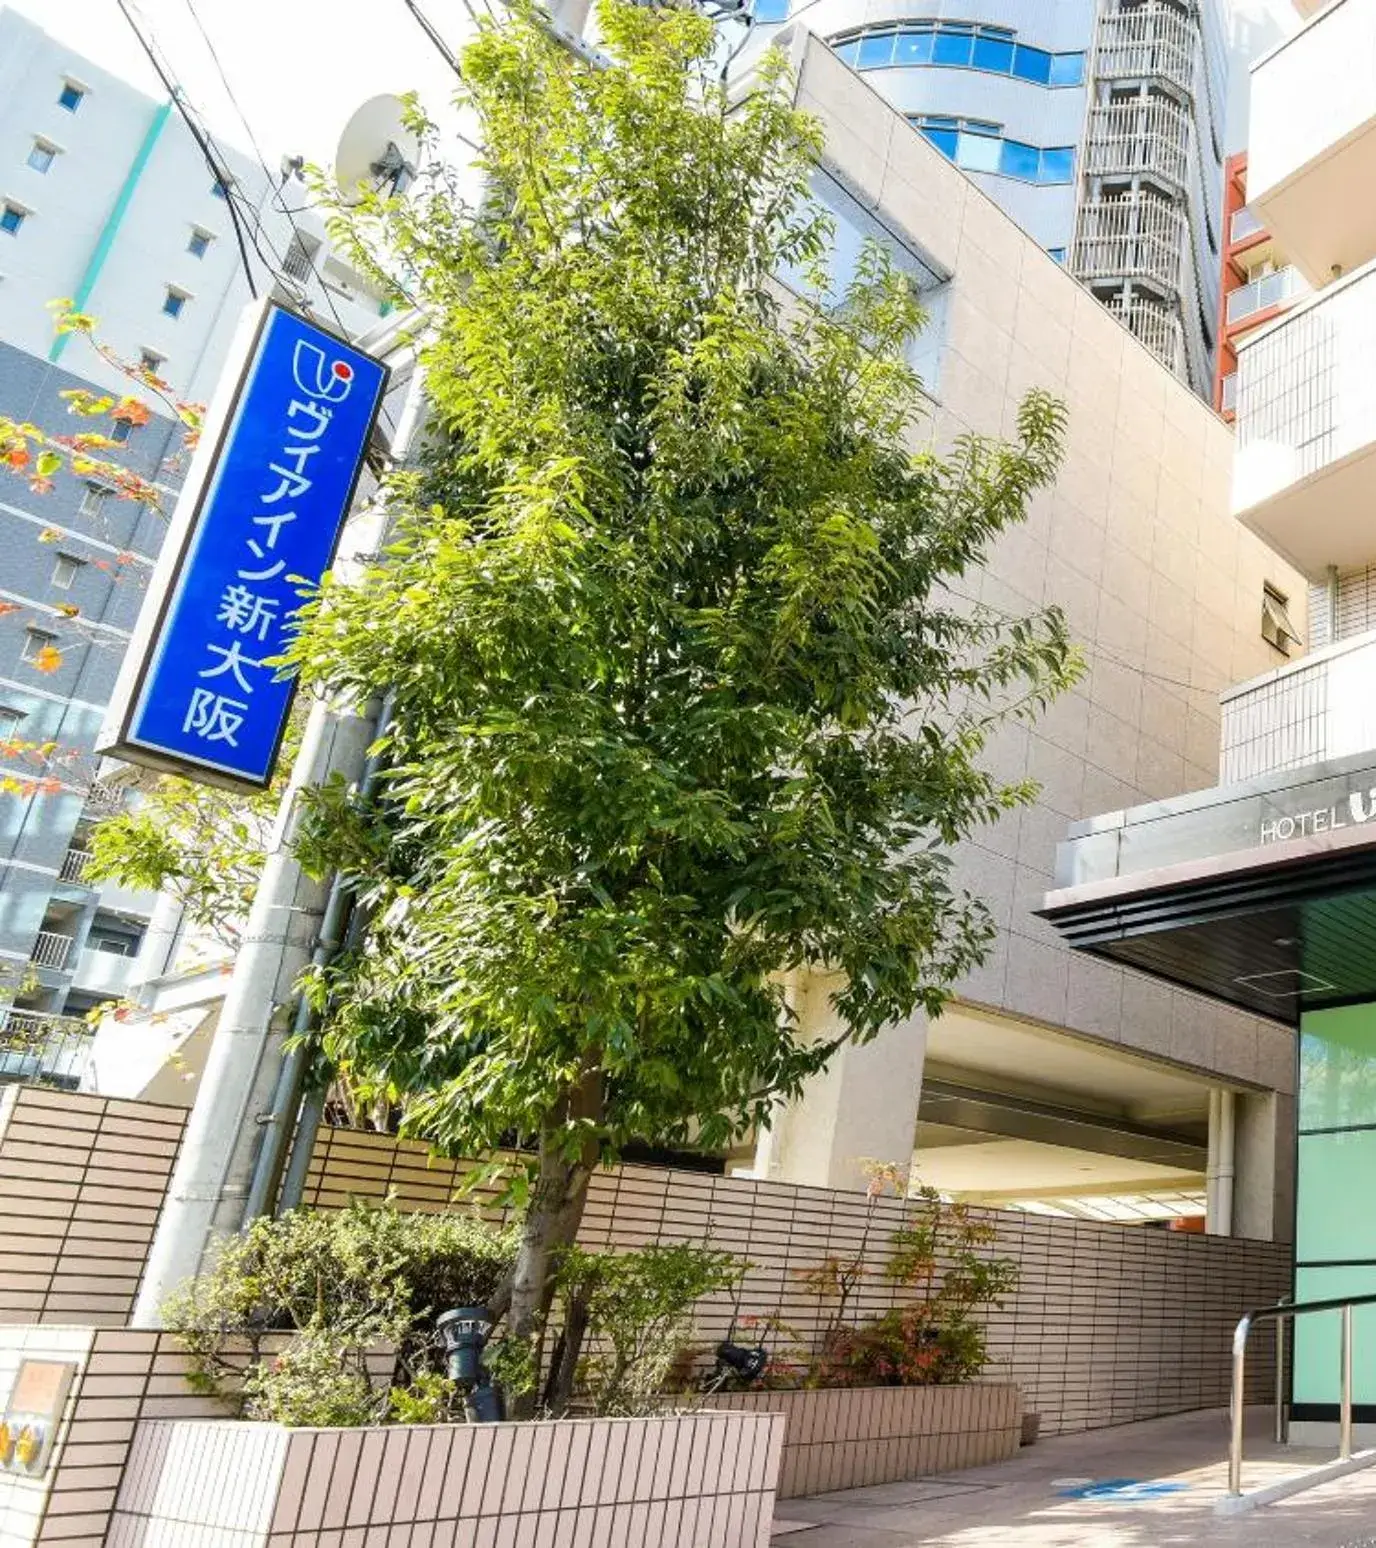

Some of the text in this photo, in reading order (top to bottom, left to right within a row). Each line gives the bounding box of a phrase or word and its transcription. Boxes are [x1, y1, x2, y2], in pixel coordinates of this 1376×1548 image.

[182, 398, 334, 748] ヴィアイン新大阪
[1260, 807, 1347, 844] HOTEL
